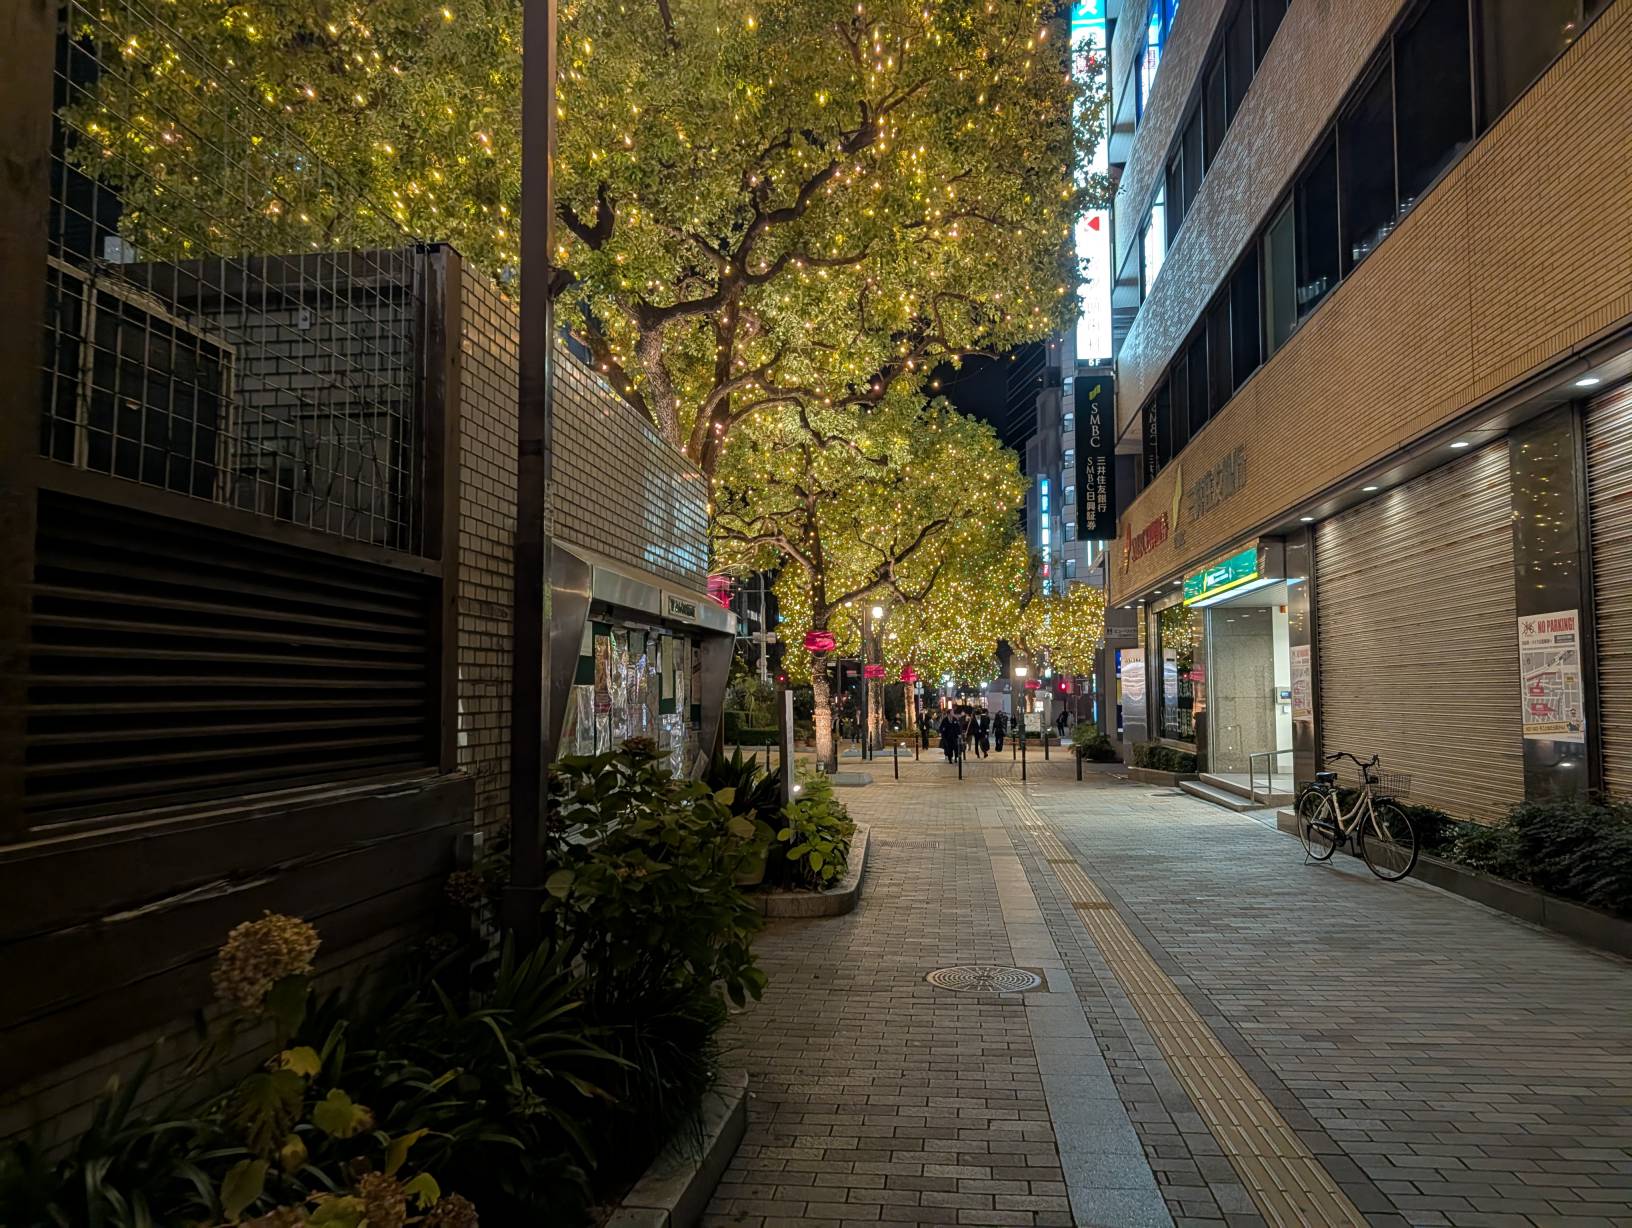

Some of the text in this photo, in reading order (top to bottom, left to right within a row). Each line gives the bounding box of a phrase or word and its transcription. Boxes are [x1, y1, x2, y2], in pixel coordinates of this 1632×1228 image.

[1089, 402, 1102, 448] SMBC
[1085, 456, 1097, 531] SMBC日興証券
[1096, 456, 1107, 513] 三井住友銀行
[1537, 621, 1547, 634] NO
